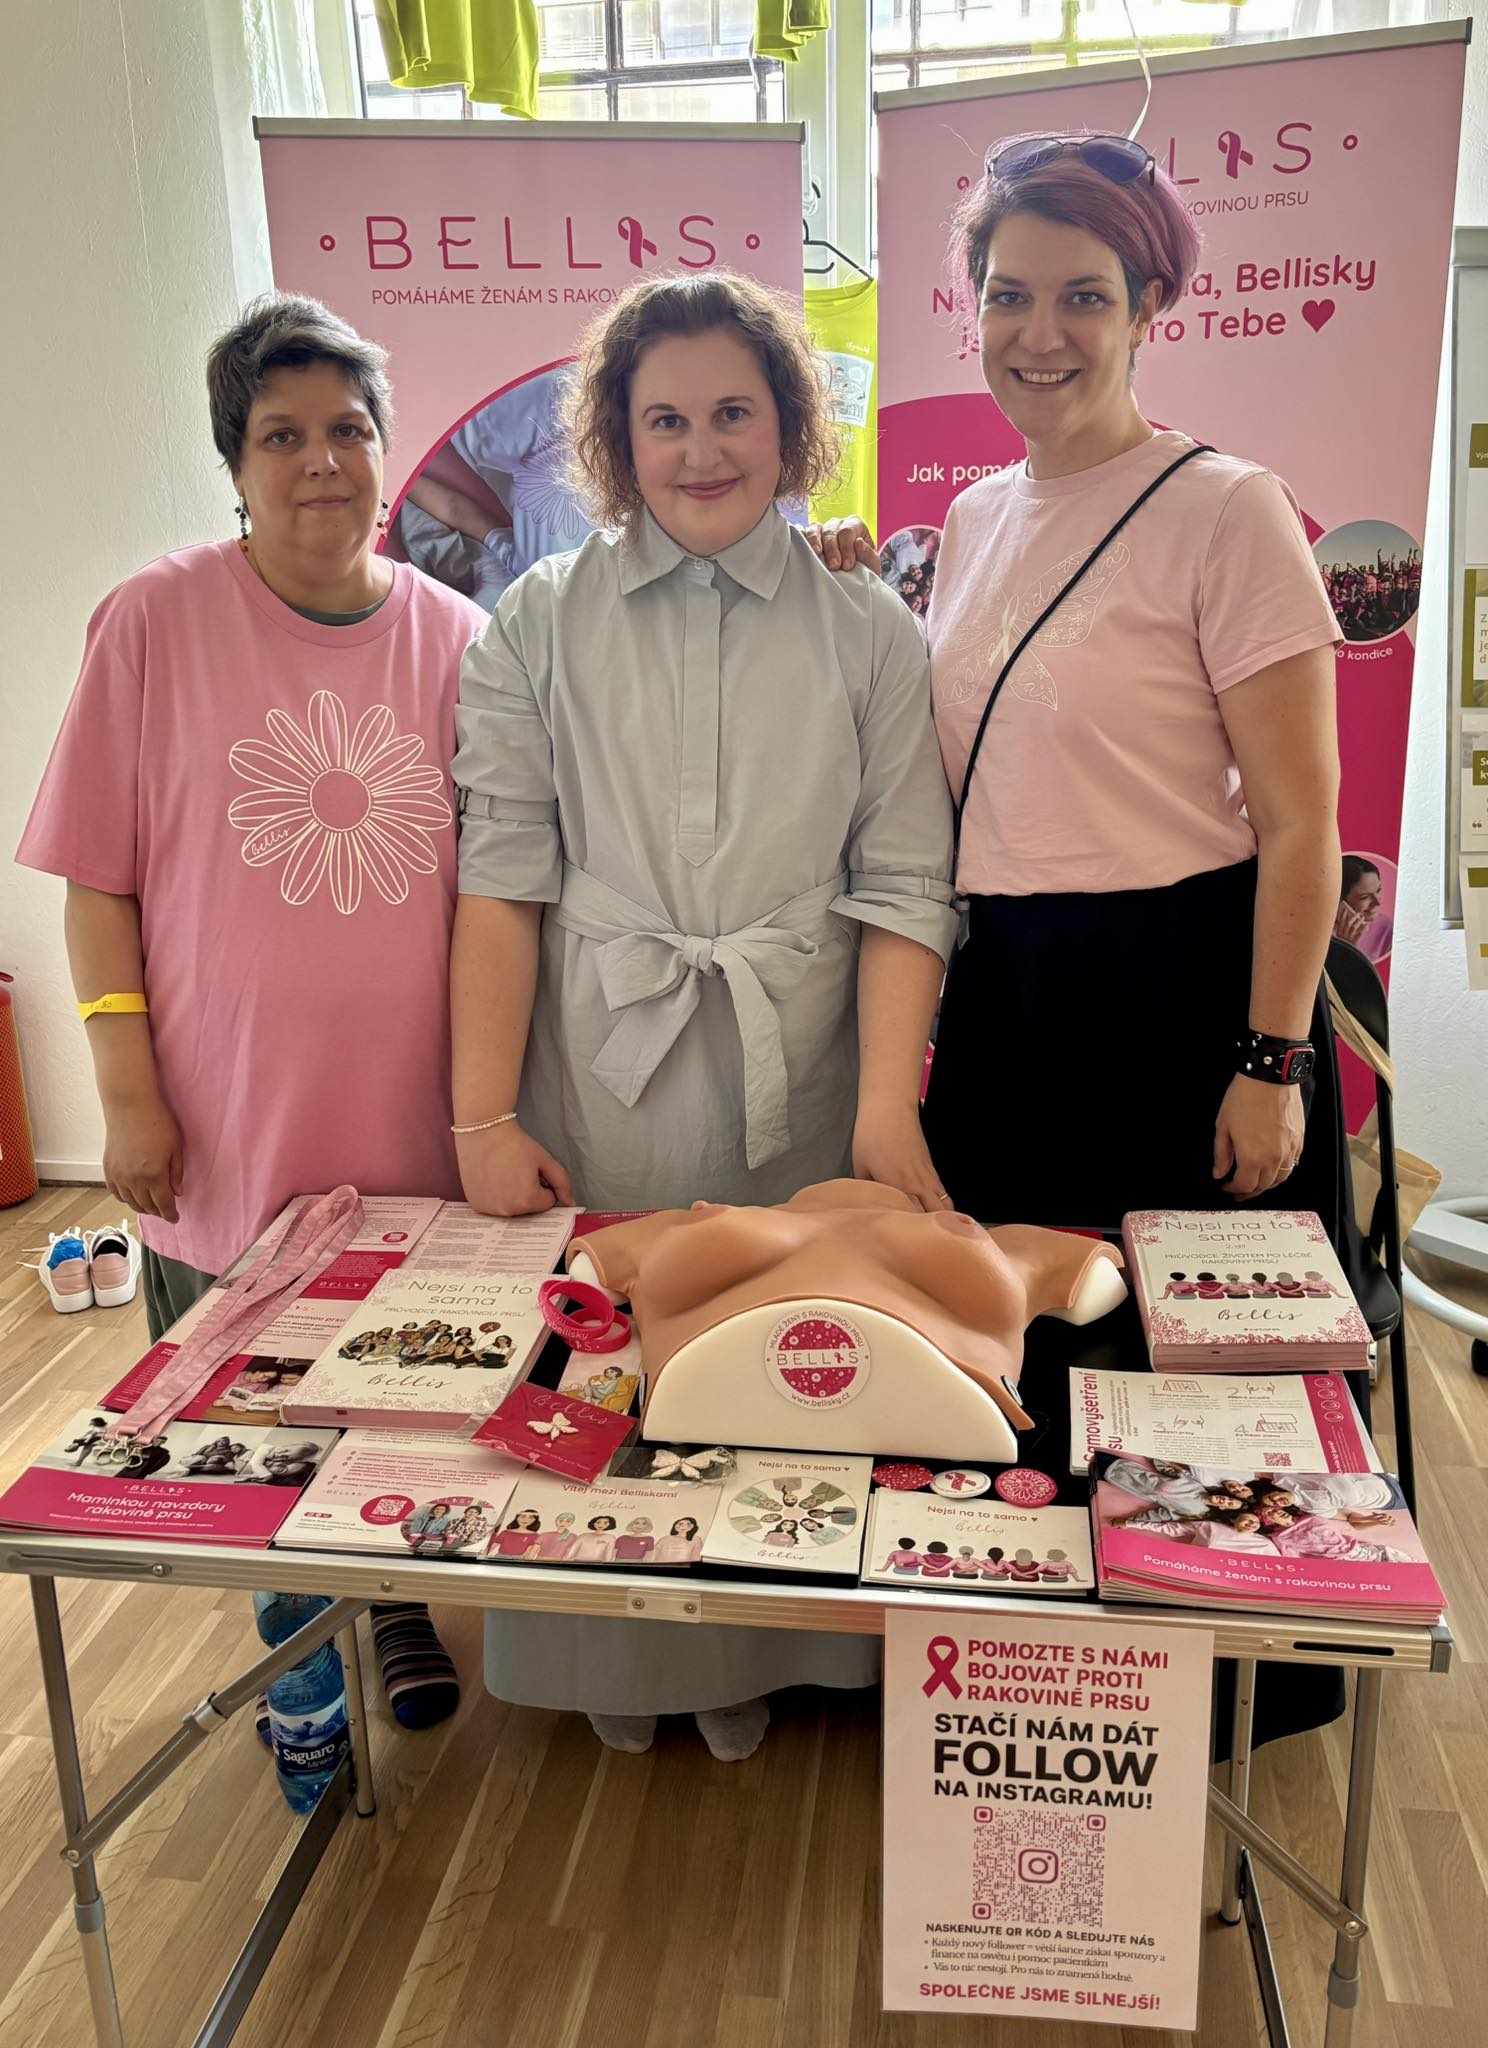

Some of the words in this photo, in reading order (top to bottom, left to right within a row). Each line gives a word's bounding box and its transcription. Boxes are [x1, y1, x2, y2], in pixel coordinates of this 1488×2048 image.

[1264, 190, 1309, 209] PRSU
[1236, 255, 1377, 293] Bellisky
[371, 286, 475, 305] POMÁHÁME
[481, 284, 542, 305] ŽENÁM
[547, 288, 558, 304] S
[1150, 320, 1185, 343] ro
[1198, 307, 1286, 340] Tebe
[906, 462, 945, 483] Jak
[1347, 647, 1393, 661] kondice
[1165, 1220, 1221, 1233] Nejsi
[1232, 1222, 1261, 1230] na
[1270, 1220, 1293, 1230] to
[1198, 1232, 1267, 1242] sama
[408, 1280, 464, 1295] Nejsi
[471, 1285, 502, 1294] na
[512, 1285, 533, 1295] to
[428, 1295, 496, 1306] sama
[1217, 1309, 1303, 1321] Bellis
[367, 1373, 453, 1390] Bellis
[533, 1394, 608, 1425] Bellis
[791, 1391, 851, 1407] www.bellisky.cz
[758, 1460, 783, 1469] Nejsi
[67, 1492, 149, 1508] Maminkou
[152, 1500, 226, 1513] navzdory
[591, 1486, 617, 1496] mezi
[620, 1489, 678, 1499] Belliskami
[157, 1511, 193, 1520] prsu
[927, 1505, 956, 1516] Nejsi
[993, 1514, 1027, 1522] sama
[1143, 1554, 1221, 1577] Pomáháme
[1225, 1570, 1271, 1584] ženám
[1275, 1577, 1283, 1585] s
[1286, 1577, 1356, 1590] rakovinou
[1360, 1582, 1392, 1592] prsu
[968, 1639, 1075, 1662] POMOZTE
[1081, 1647, 1096, 1664] S
[1102, 1645, 1169, 1669] NÁMI
[967, 1662, 1069, 1684] BOJOVAT
[1077, 1669, 1143, 1689] PROTI
[967, 1684, 1083, 1707] RAKOVINĚ
[1090, 1692, 1150, 1711] PRSU
[934, 1712, 1018, 1737] STAČÍ
[1026, 1716, 1093, 1742] NÁM
[1103, 1721, 1159, 1746] DÁT
[283, 1743, 335, 1765] Saguaro
[934, 1738, 1159, 1787] FOLLOW
[934, 1779, 969, 1797] NA
[977, 1782, 1152, 1809] INSTAGRAMU!
[926, 1923, 1002, 1935] NASKENUJTE
[1006, 1927, 1022, 1936] QR
[1025, 1926, 1052, 1938] KÓD
[1054, 1931, 1063, 1939] A
[1066, 1930, 1127, 1943] SLEDUJTE
[1130, 1934, 1155, 1946] NÁS
[931, 1949, 966, 1959] finance
[980, 1951, 1011, 1961] osvětu
[1017, 1954, 1052, 1964] pomoc
[1053, 1955, 1109, 1967] pacientkám
[932, 1937, 960, 1949] Každý
[962, 1940, 986, 1950] nový
[987, 1939, 1026, 1951] follower
[1035, 1943, 1056, 1953] větší
[1057, 1944, 1085, 1955] šance
[1085, 1946, 1112, 1957] získat
[1113, 1950, 1159, 1963] sponzory
[933, 1962, 949, 1971] Vás
[961, 1964, 976, 1972] nic
[1010, 1965, 1027, 1974] Pro
[1028, 1966, 1044, 1976] nás
[1045, 1968, 1055, 1976] to
[1056, 1969, 1100, 1980] znamená
[1020, 1986, 1070, 2003] JSME
[1074, 1990, 1161, 2010] SILNEJŠÍ!
